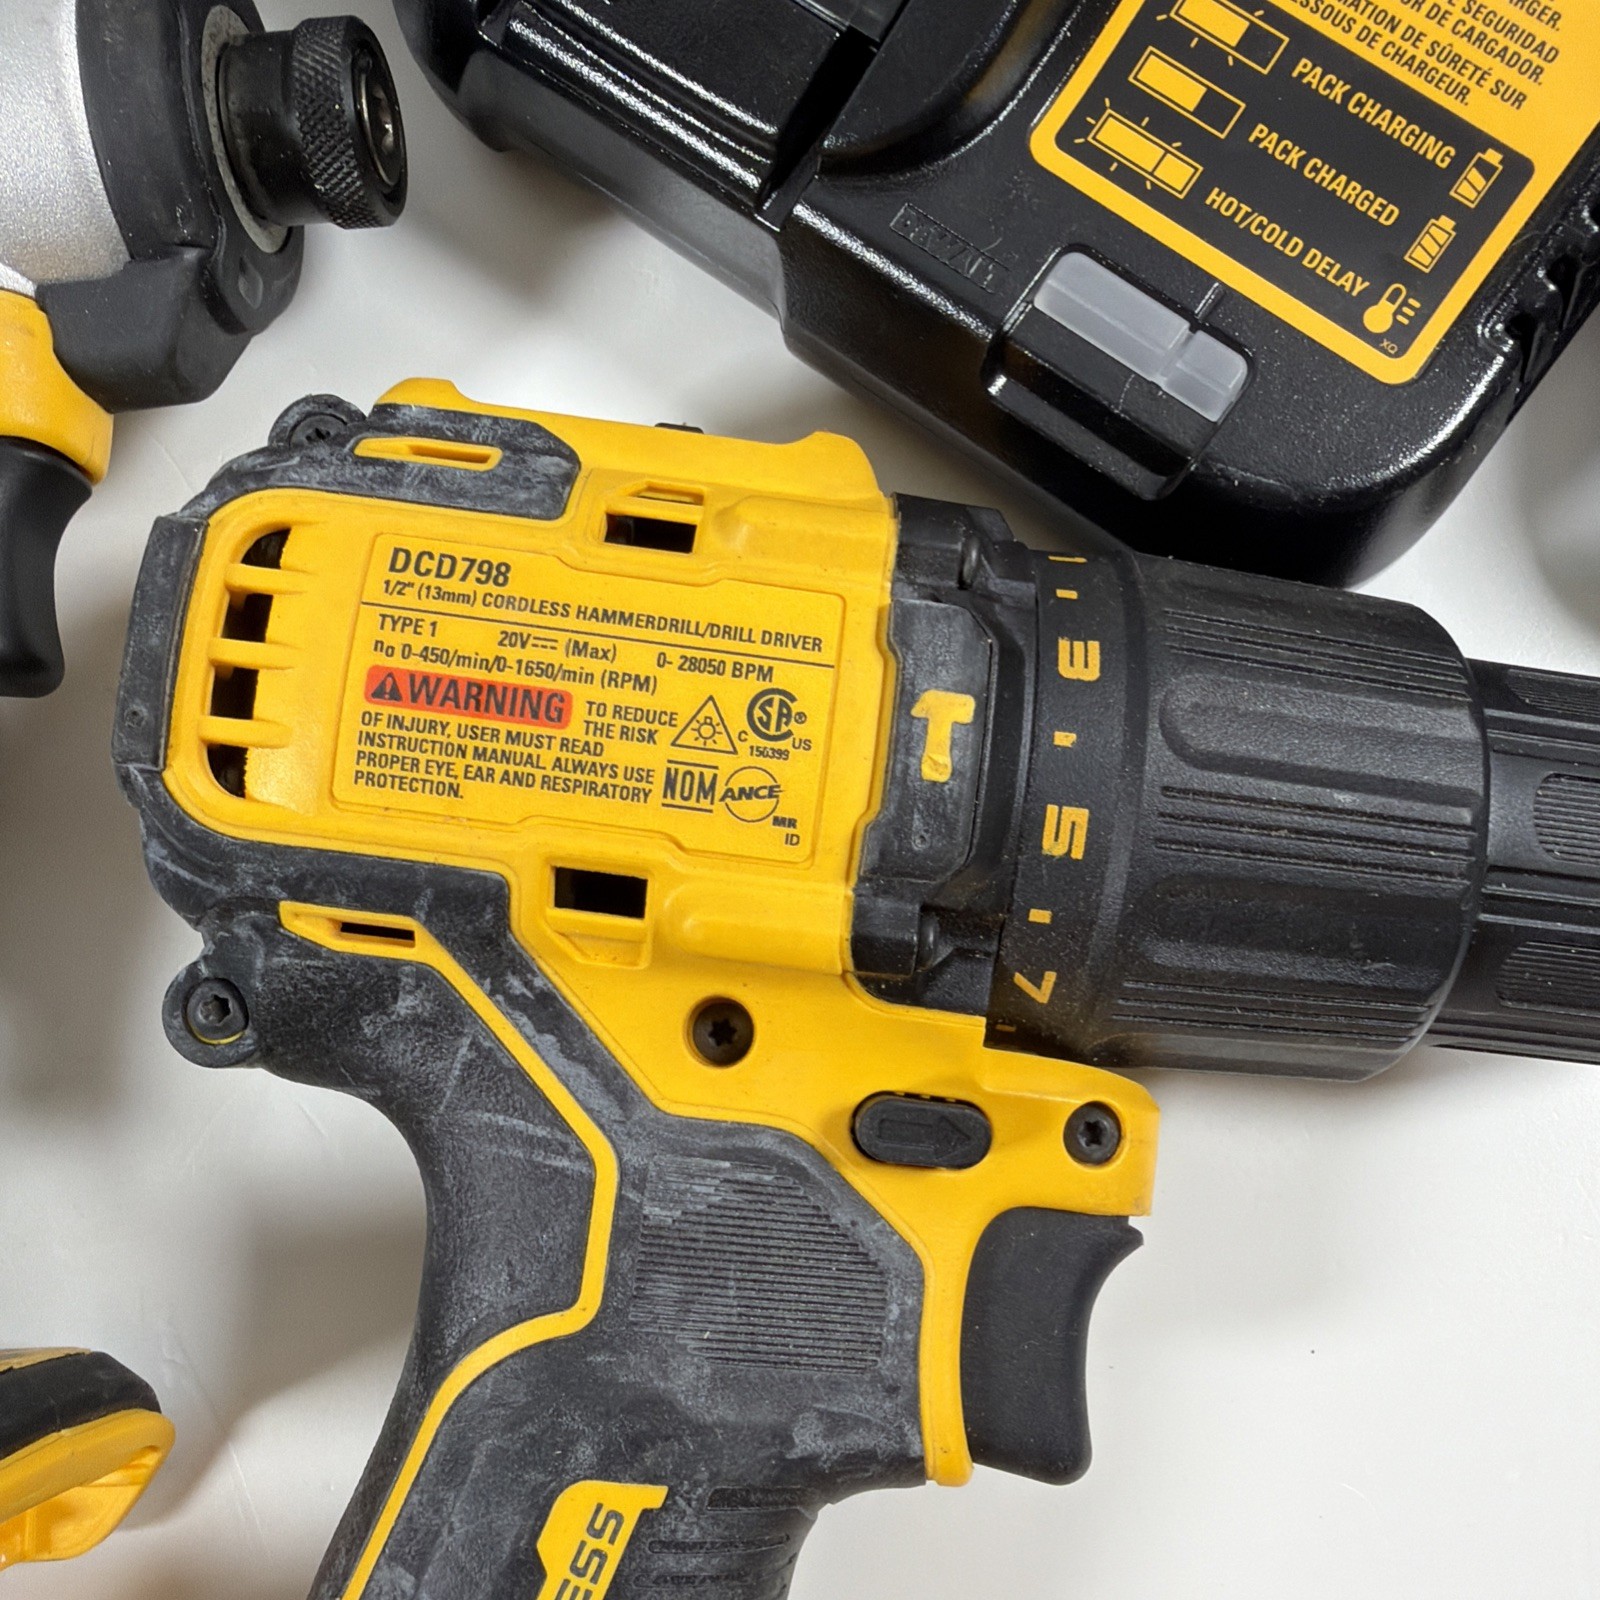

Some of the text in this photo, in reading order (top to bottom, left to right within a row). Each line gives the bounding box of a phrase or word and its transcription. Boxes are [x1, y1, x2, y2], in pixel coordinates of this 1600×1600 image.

[1425, 2, 1453, 28] DE
[1451, 18, 1545, 86] CARGADOR.
[1461, 0, 1560, 64] SEGURIDAD
[1355, 25, 1383, 50] DE
[1381, 41, 1471, 106] CHARGEUR.
[1400, 24, 1427, 50] DE
[1425, 40, 1493, 88] SÛRETÉ
[1489, 79, 1528, 110] SUR
[1291, 57, 1456, 169] PACK CHARGING
[1248, 123, 1400, 227] PACK CHARGED
[1204, 186, 1371, 298] HOT/COLD DELAY
[388, 547, 512, 587] DCD798
[417, 583, 477, 607] (13mm)
[482, 592, 571, 618] CORDLESS
[576, 605, 756, 644] HAMMERDRILL/DRILL
[760, 630, 823, 653] DRIVER
[379, 613, 424, 637] TYPE
[429, 621, 438, 637] 1
[565, 638, 617, 665] (Max)
[677, 655, 727, 676] 28050
[731, 662, 774, 683] BPM
[1058, 637, 1100, 682] 3
[406, 673, 565, 723] WARNING
[600, 669, 657, 696] (RPM)
[361, 711, 604, 757] OF INJURY, USER MUST READ
[583, 720, 659, 745] THE RISK
[586, 700, 678, 727] TO REDUCE
[357, 730, 467, 759] INSTRUCTION
[551, 756, 619, 779] ALWAYS
[623, 766, 655, 784] USE
[791, 737, 812, 752] US
[354, 770, 464, 799] PROTECTION.
[355, 750, 420, 773] PROPER
[463, 764, 495, 783] EAR
[499, 769, 536, 788] AND
[541, 774, 652, 804] RESPIRATORY
[662, 767, 784, 806] NOM ANCE
[784, 833, 800, 846] ID
[1042, 804, 1089, 860] 5
[1013, 971, 1057, 1004] 7
